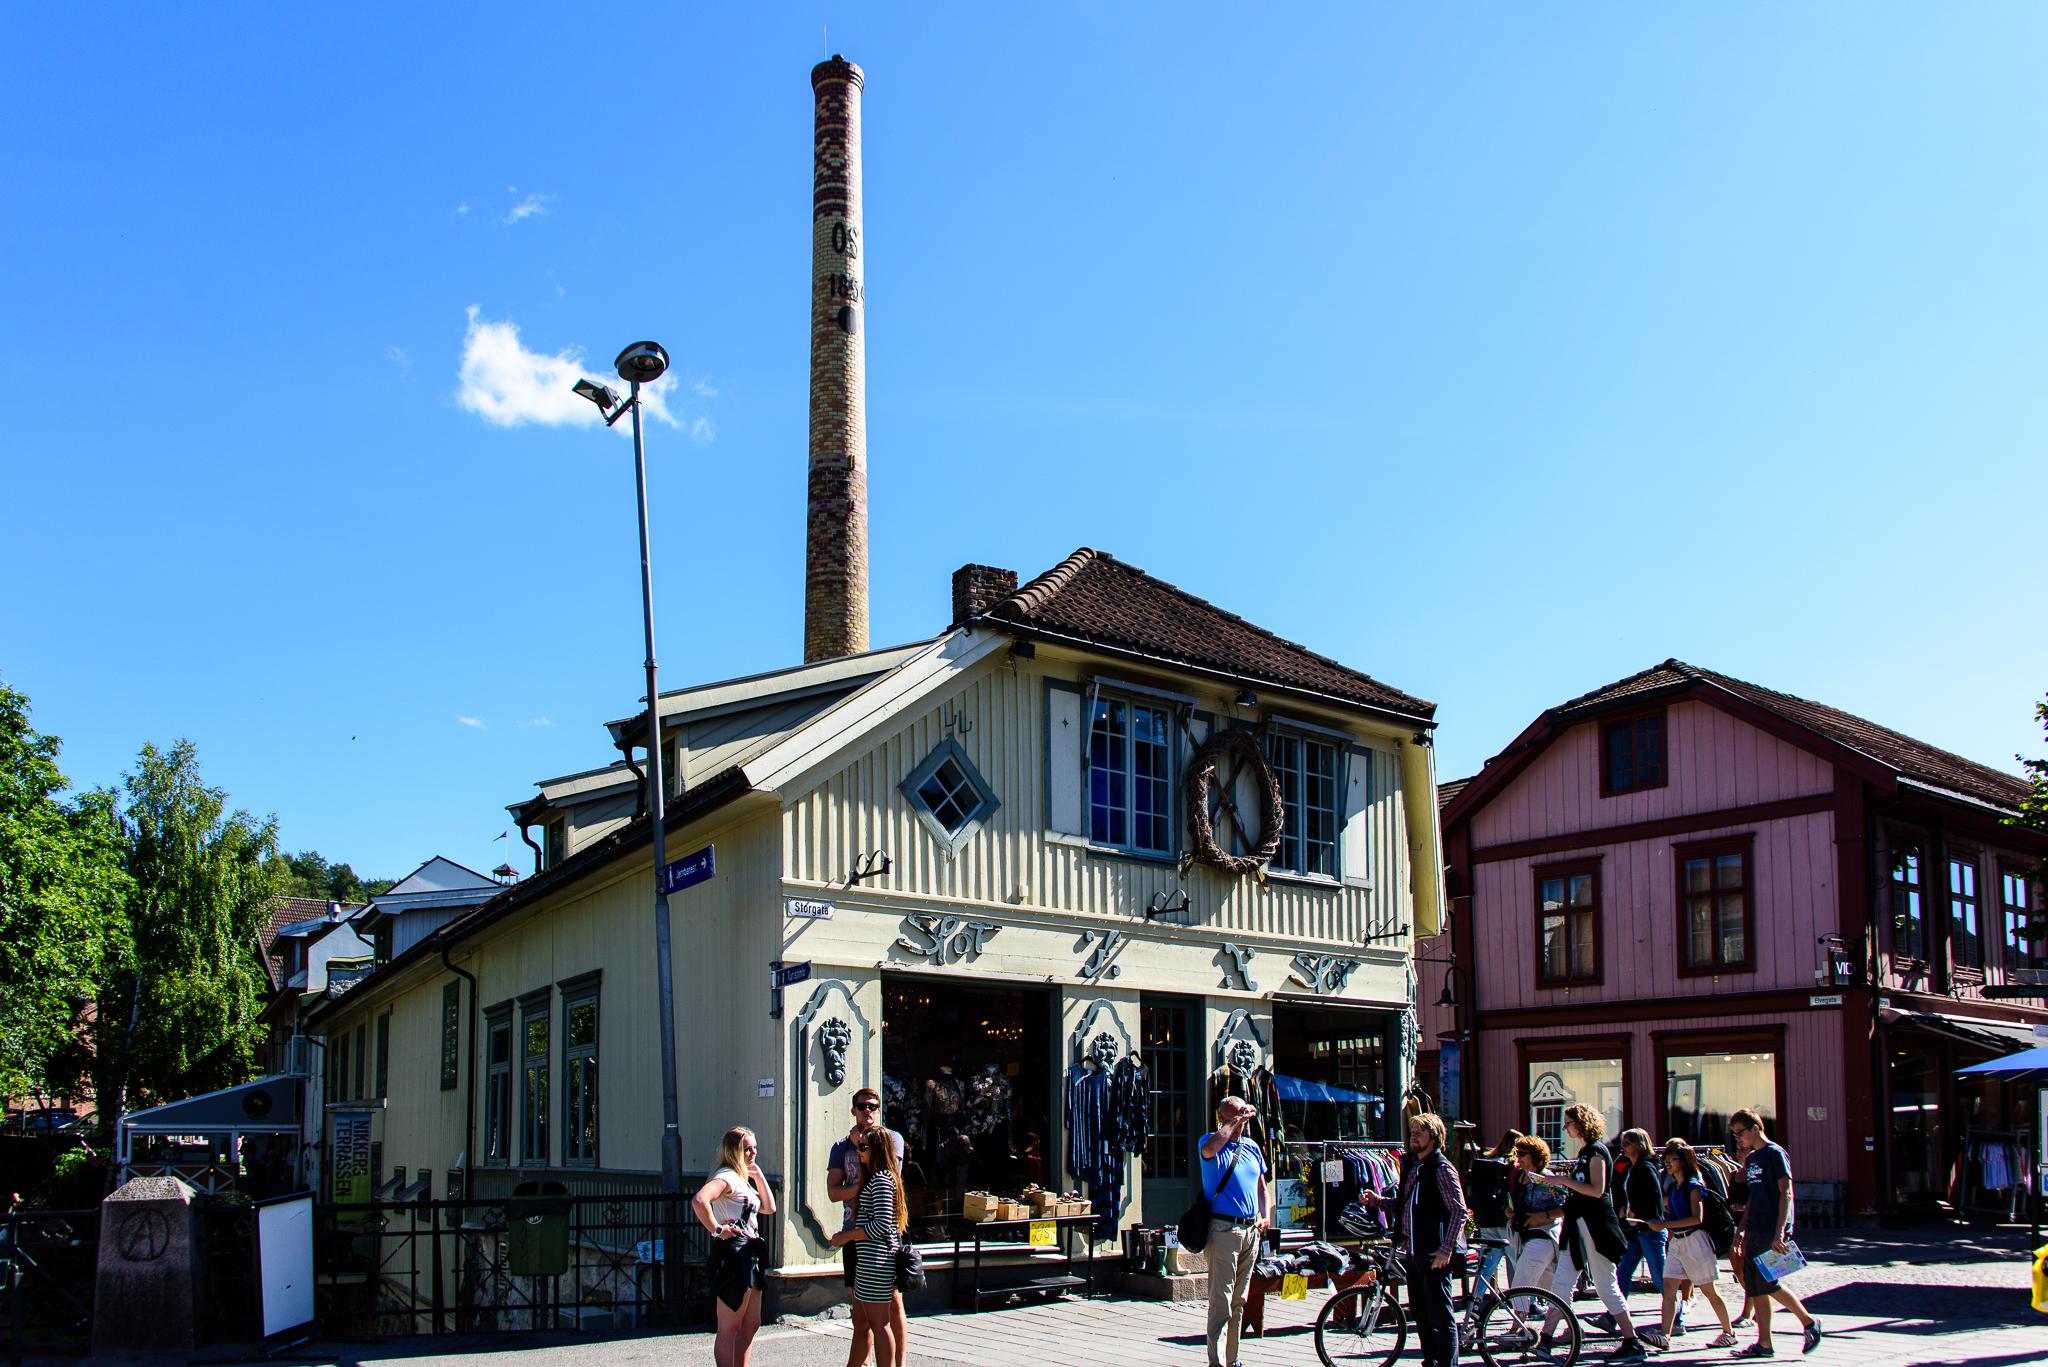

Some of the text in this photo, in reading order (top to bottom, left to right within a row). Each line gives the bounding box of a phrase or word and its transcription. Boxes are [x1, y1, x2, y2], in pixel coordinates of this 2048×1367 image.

[794, 901, 829, 917] Storgata
[1814, 996, 1837, 1005] Elvegata
[336, 1119, 352, 1197] TERRASSEN
[353, 1118, 370, 1177] NIKKERS
